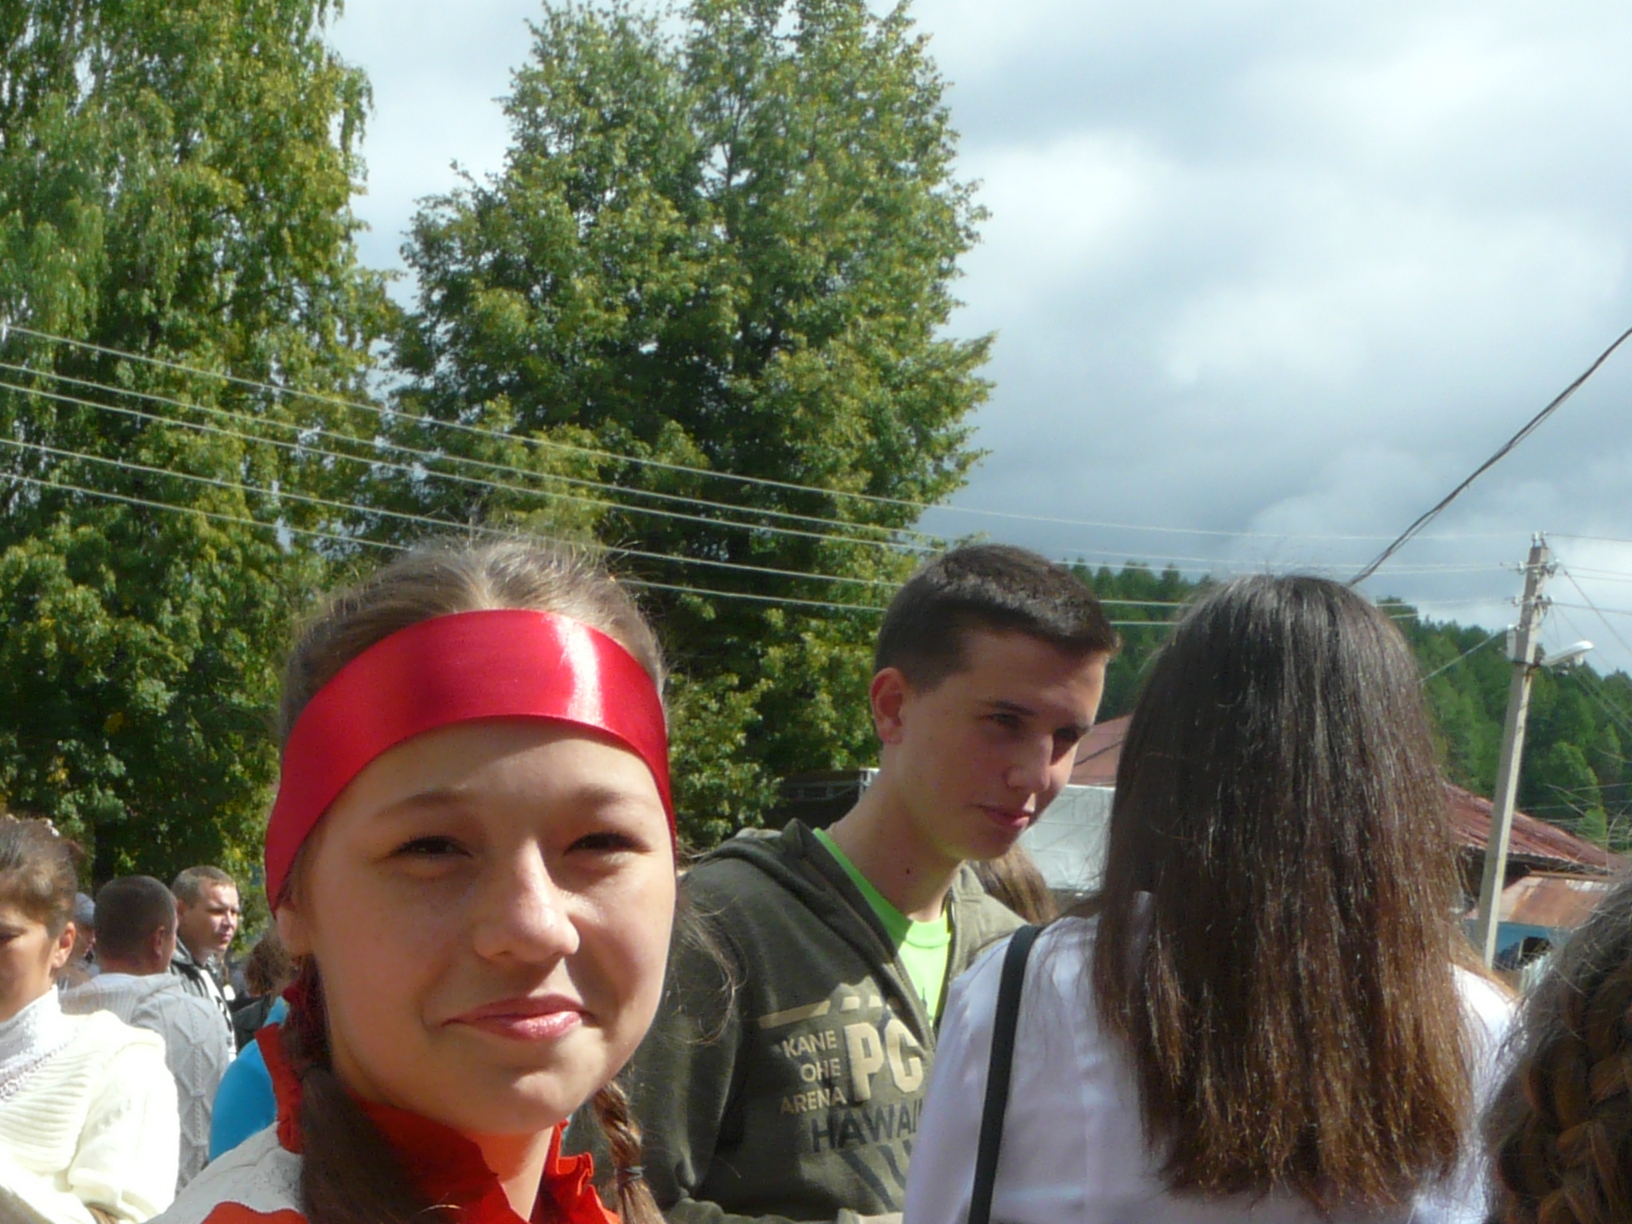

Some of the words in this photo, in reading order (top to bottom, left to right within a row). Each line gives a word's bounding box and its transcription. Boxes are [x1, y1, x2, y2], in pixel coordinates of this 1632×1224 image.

[782, 1029, 838, 1059] KANE
[799, 1058, 842, 1083] OHE
[779, 1086, 848, 1116] ARENA
